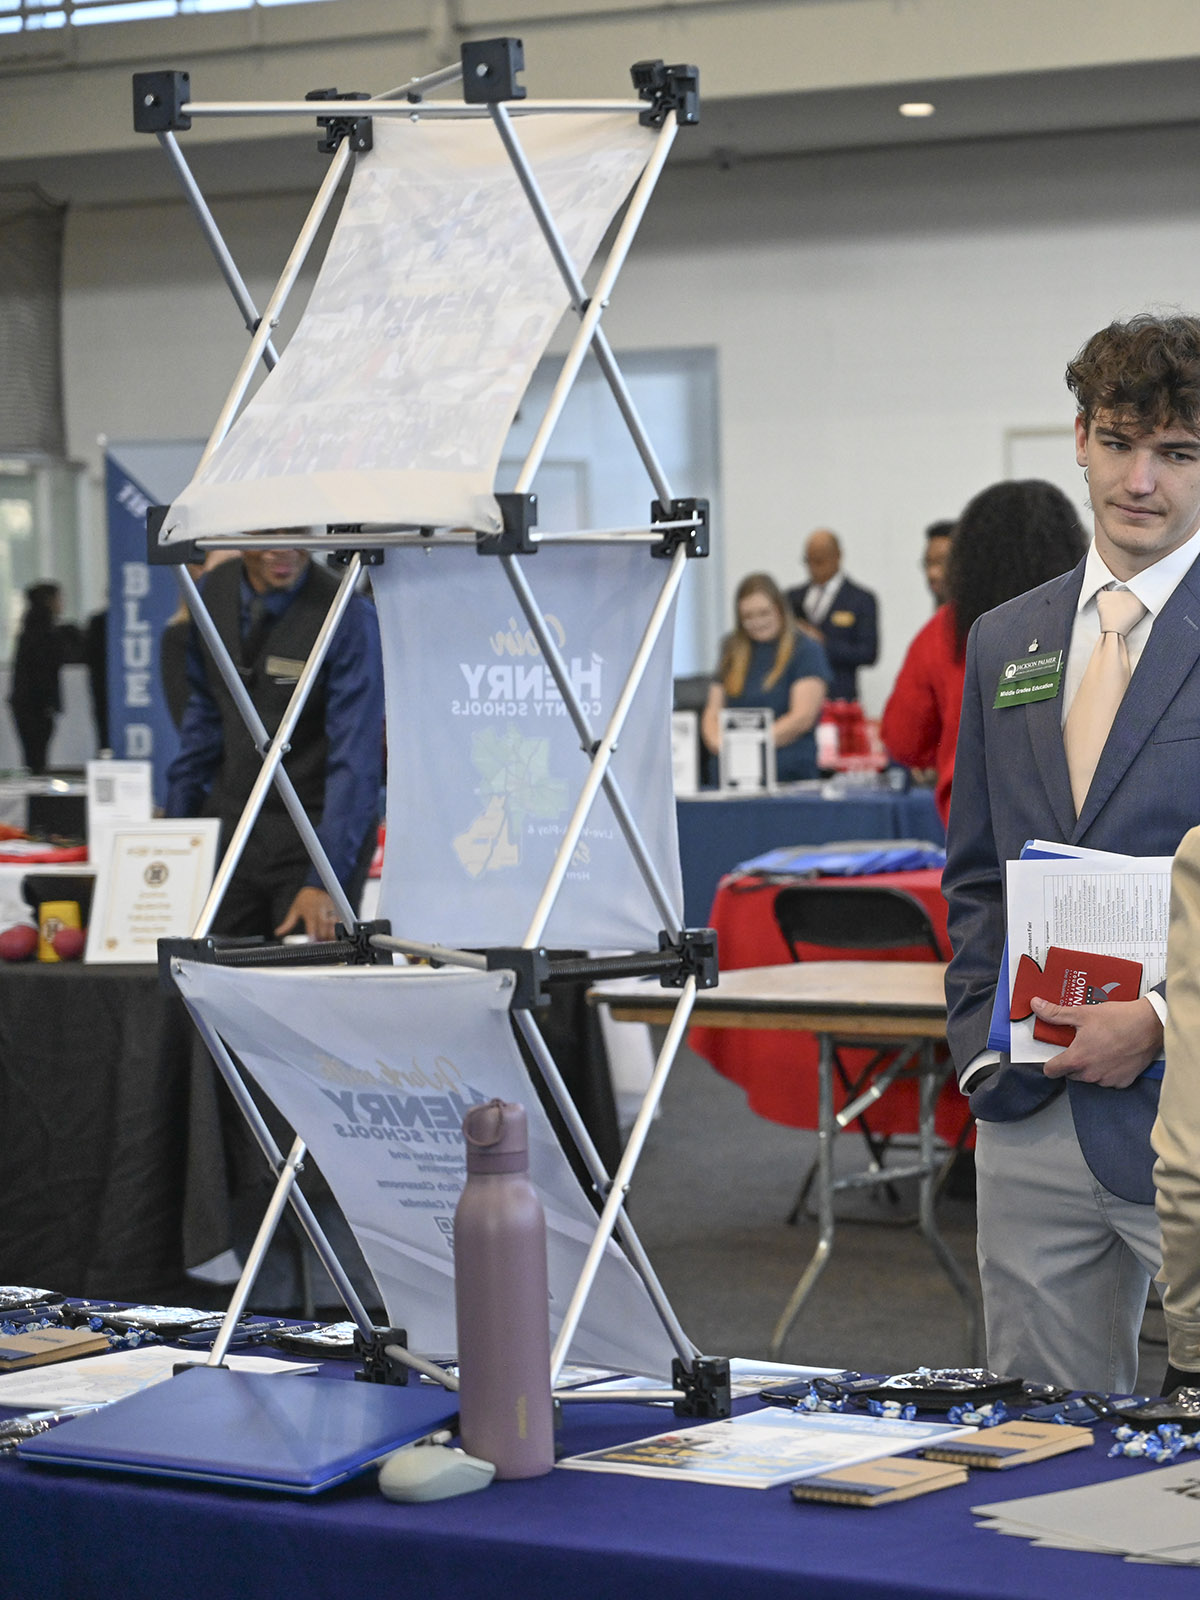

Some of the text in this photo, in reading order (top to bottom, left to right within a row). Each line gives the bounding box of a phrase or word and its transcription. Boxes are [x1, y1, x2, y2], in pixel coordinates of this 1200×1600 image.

[1016, 661, 1037, 671] JACKSON
[1038, 657, 1057, 666] PALMER
[1000, 682, 1054, 697] Middle Grades Education
[1068, 970, 1078, 995] COUNTY
[1073, 970, 1088, 1007] LOWN
